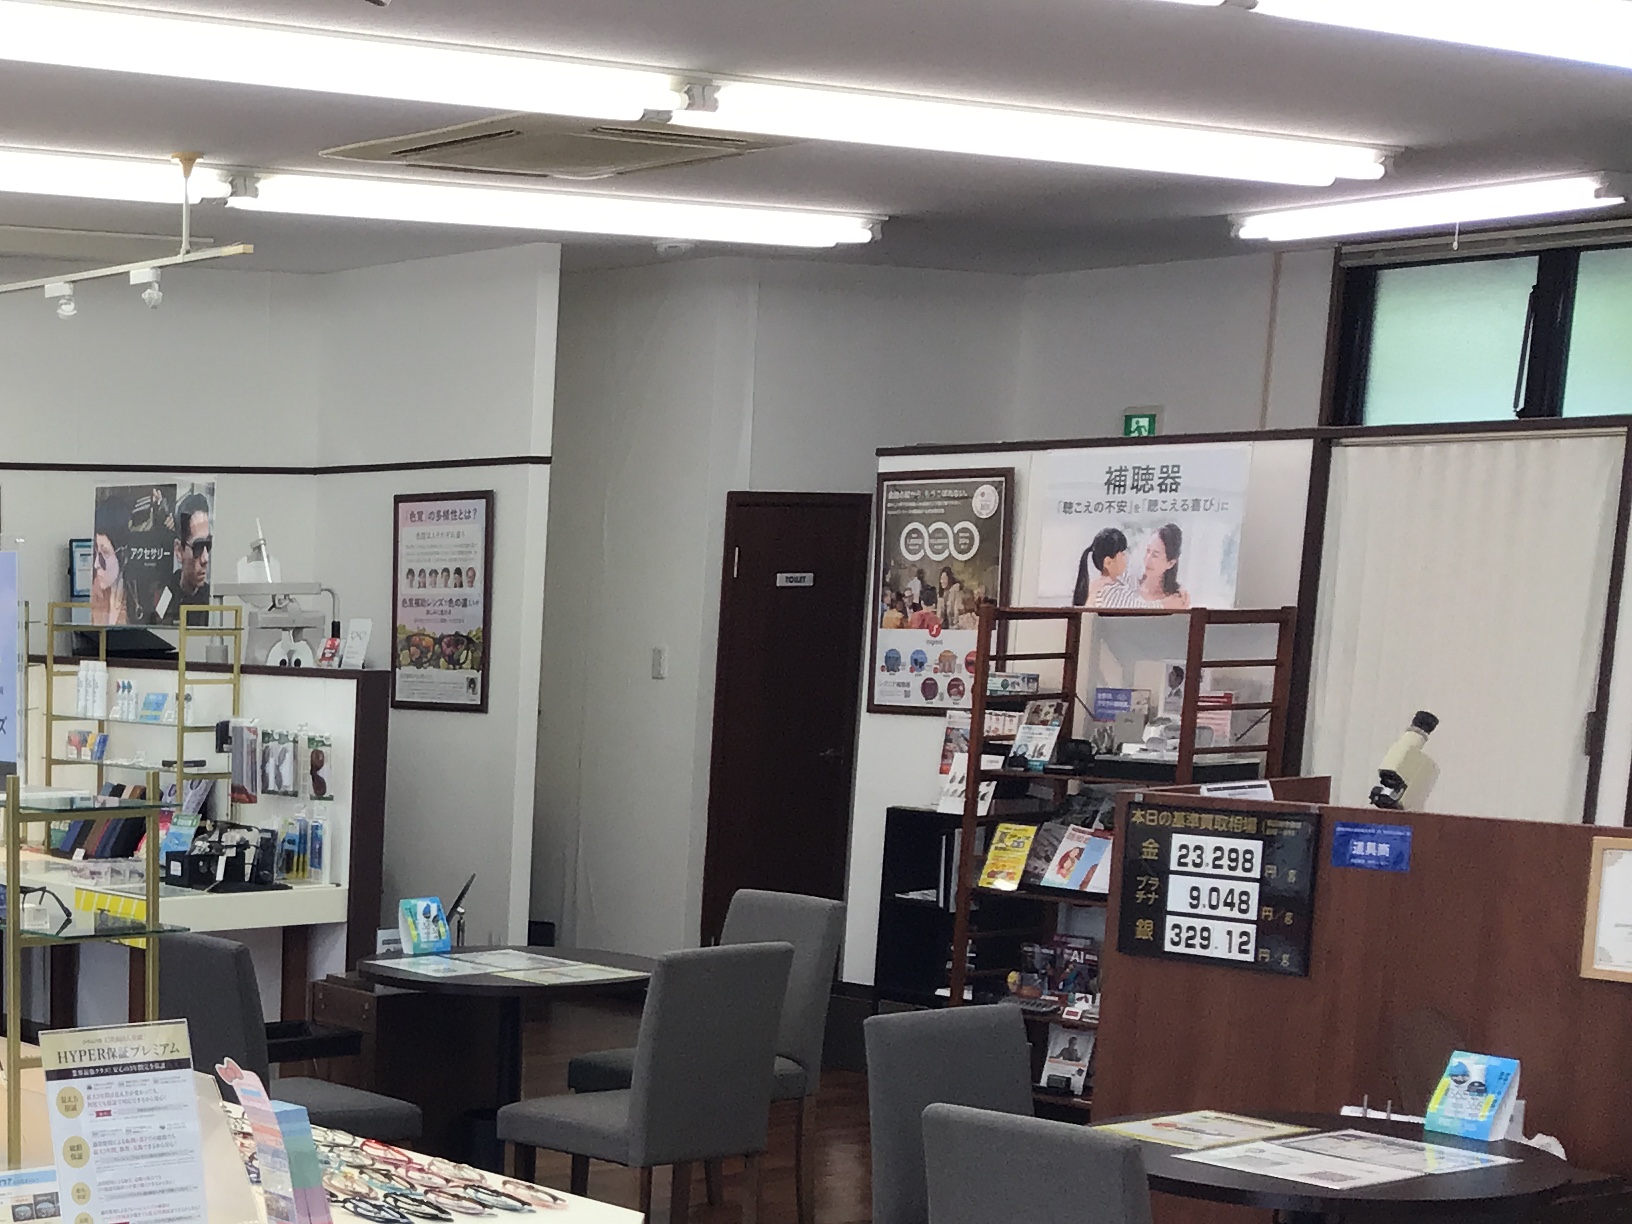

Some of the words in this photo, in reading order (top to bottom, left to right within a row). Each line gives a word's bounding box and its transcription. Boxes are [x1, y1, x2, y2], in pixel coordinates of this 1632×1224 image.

[1104, 464, 1182, 495] 補聴器
[130, 548, 171, 560] アクセサリー
[1141, 838, 1160, 860] 金
[1135, 918, 1154, 942] 銀
